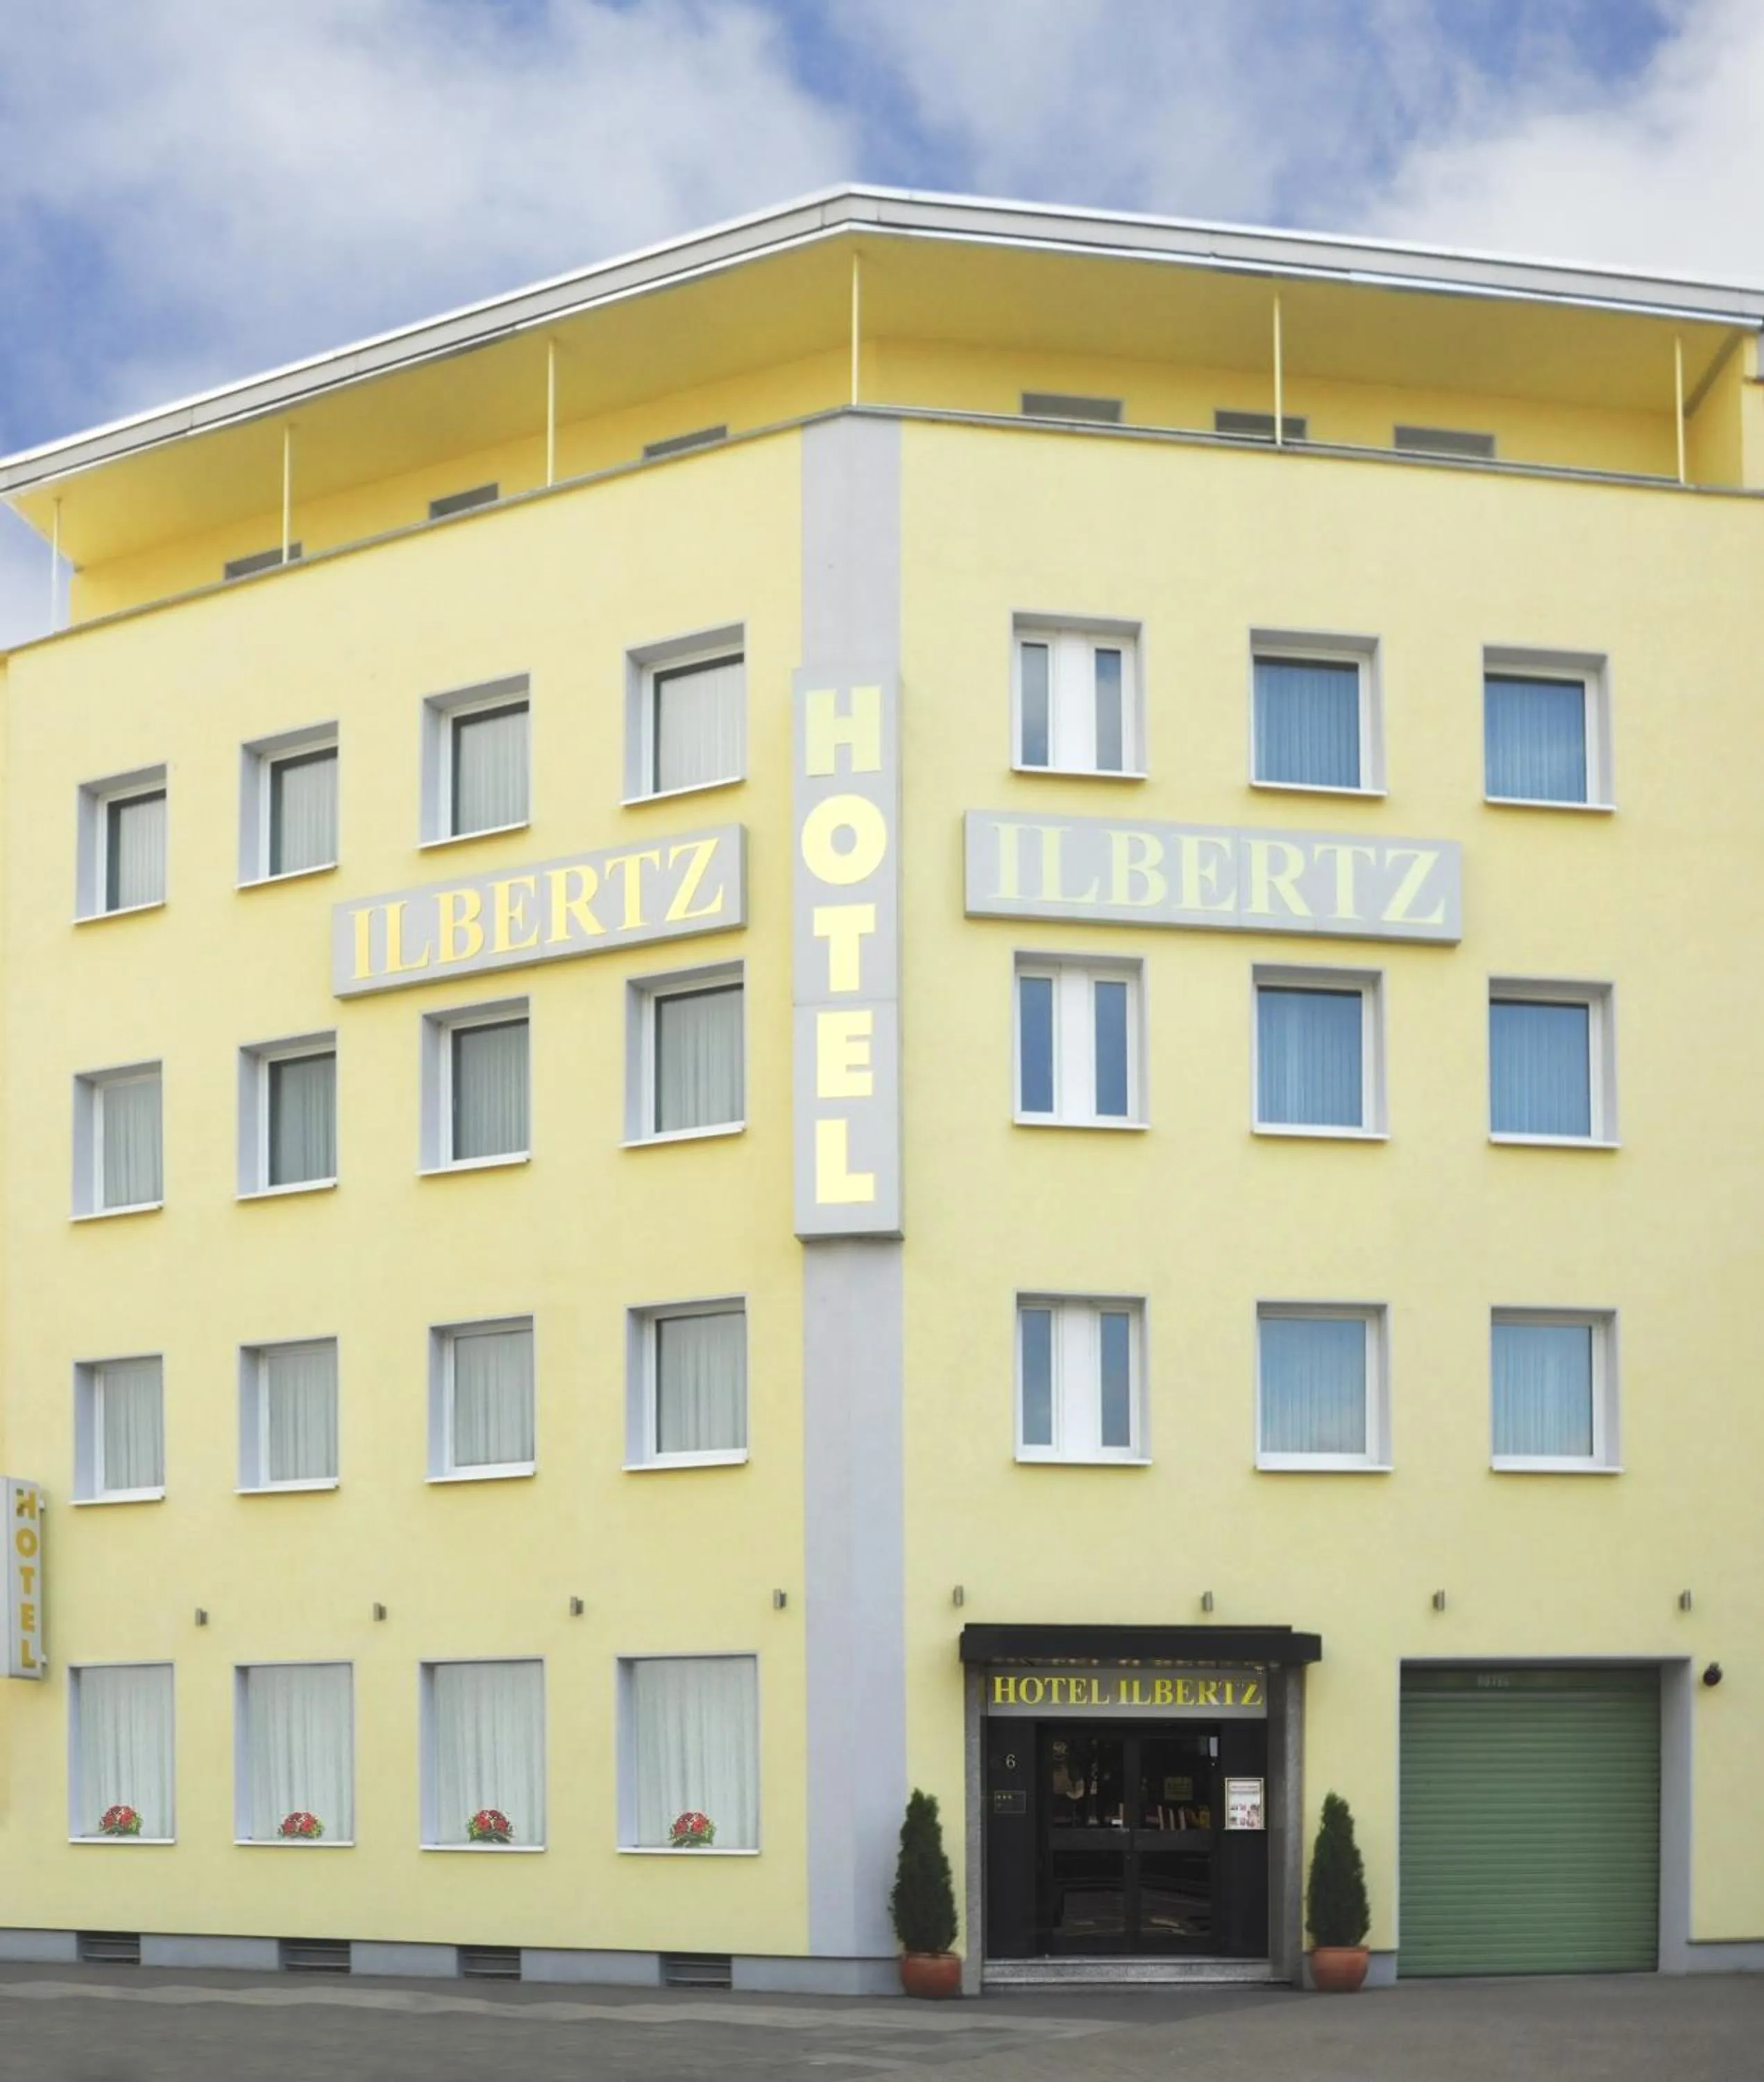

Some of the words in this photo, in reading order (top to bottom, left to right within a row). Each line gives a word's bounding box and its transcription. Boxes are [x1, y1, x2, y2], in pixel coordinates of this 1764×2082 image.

[349, 837, 724, 981] ILBERTZ
[987, 822, 1446, 924] ILBERTZ
[801, 685, 887, 1204] HOTEL
[16, 1488, 37, 1670] HOTEL
[992, 1675, 1110, 1705] HOTEL
[1117, 1678, 1264, 1707] ILBERTZ
[1006, 1754, 1016, 1769] 6
